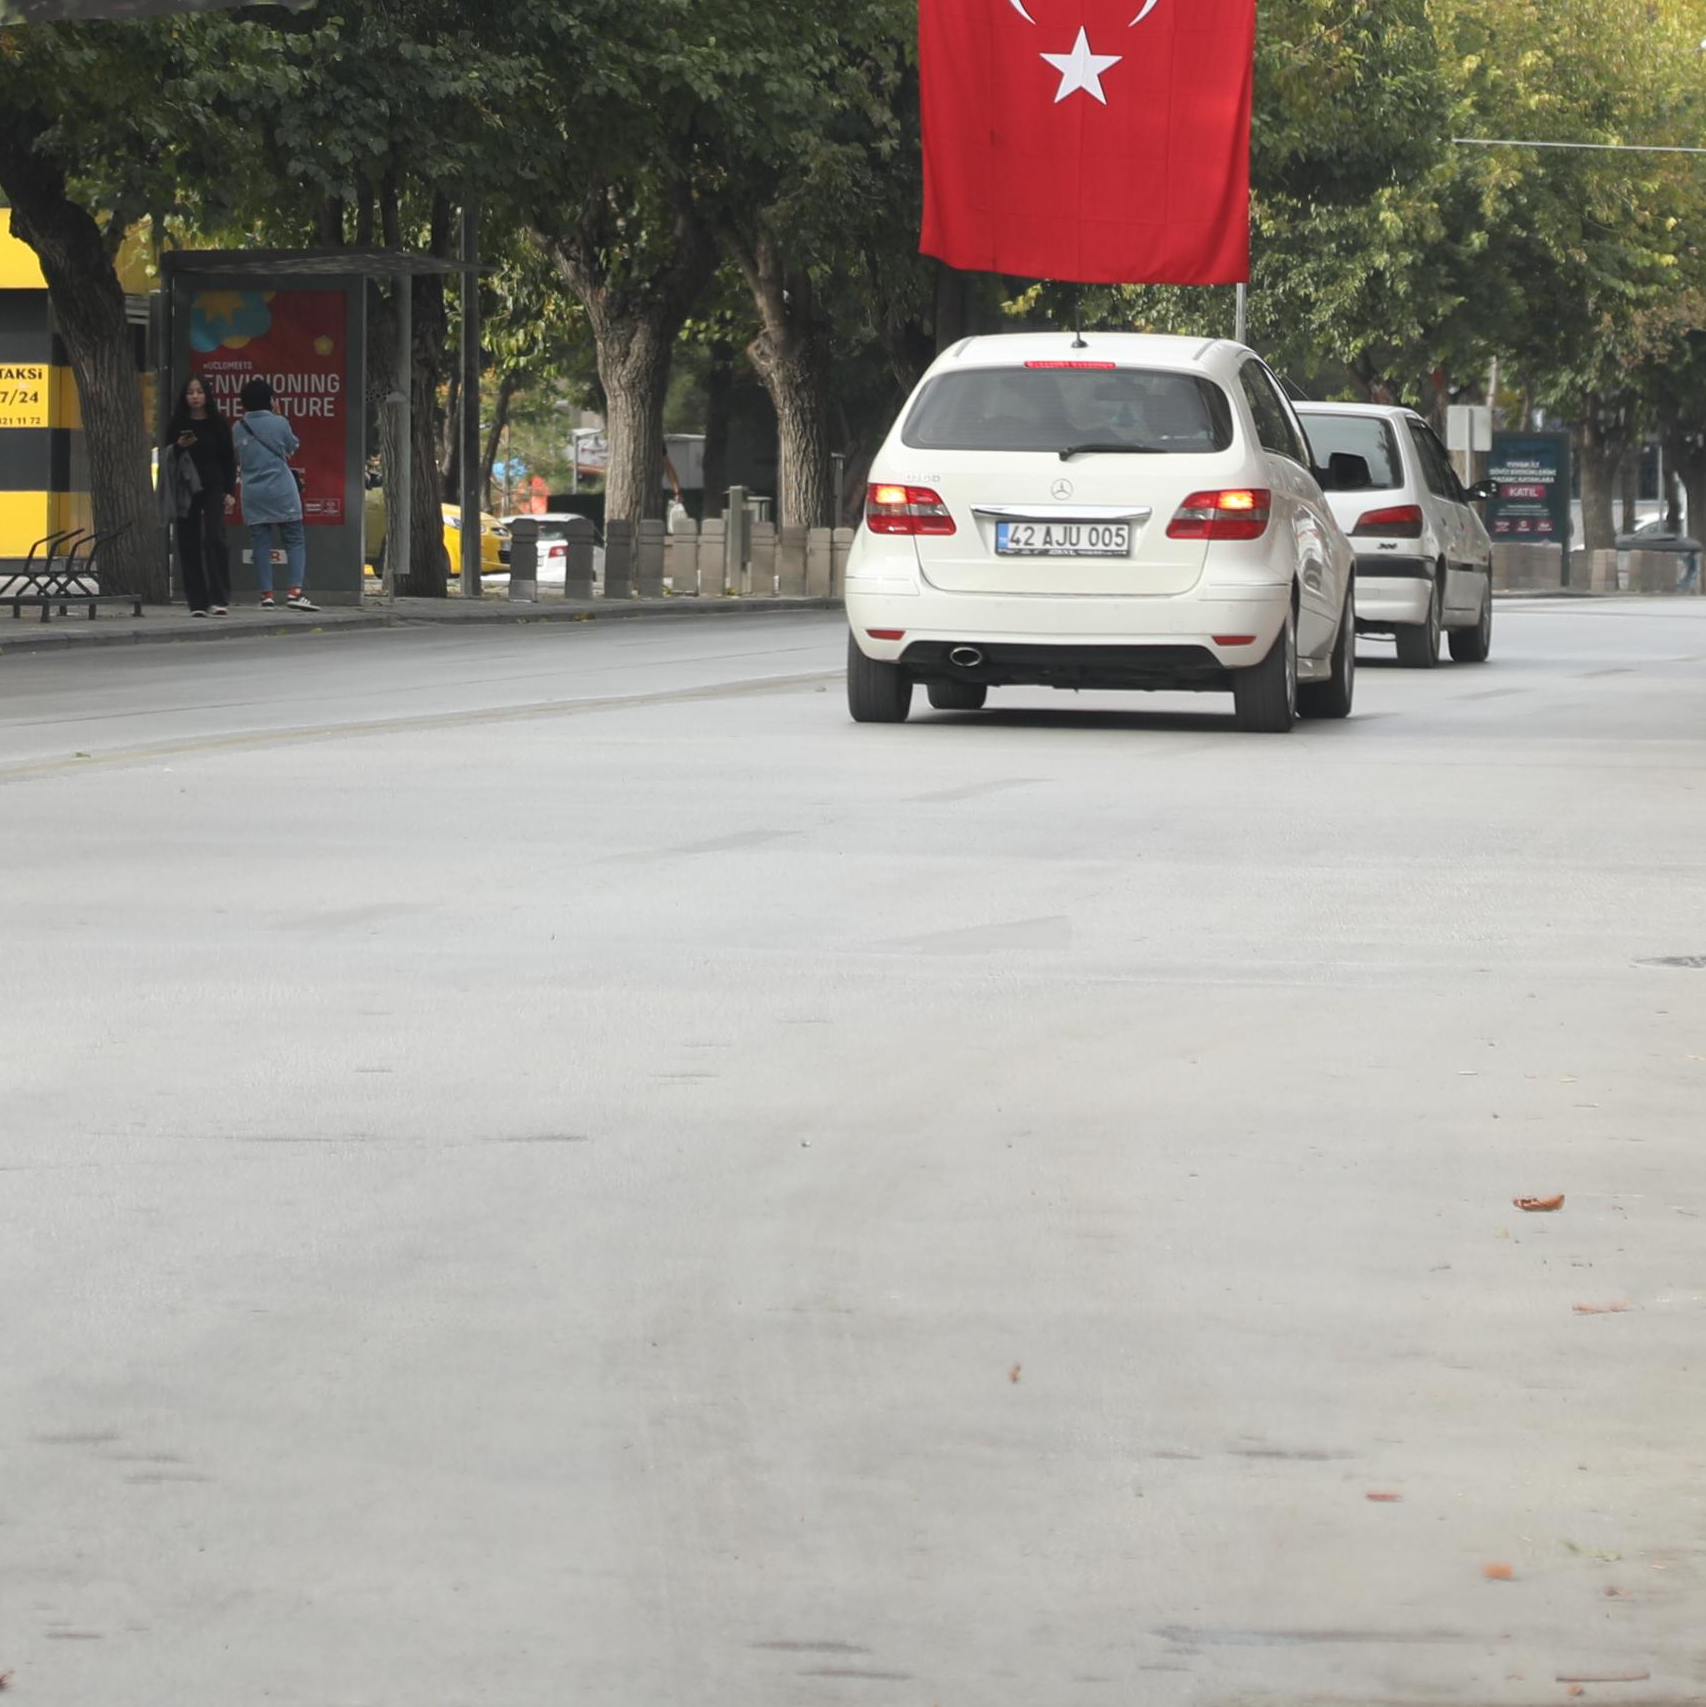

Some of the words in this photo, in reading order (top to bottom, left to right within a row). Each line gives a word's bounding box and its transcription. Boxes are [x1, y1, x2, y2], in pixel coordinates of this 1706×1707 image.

[0, 389, 39, 405] 7/24
[216, 397, 243, 417] HE
[271, 397, 336, 417] TURE
[17, 417, 27, 425] 11
[30, 417, 41, 425] 72
[1509, 487, 1538, 497] KATIL
[1009, 526, 1035, 546] 42
[1042, 526, 1081, 547] AJU
[1088, 526, 1126, 548] 005
